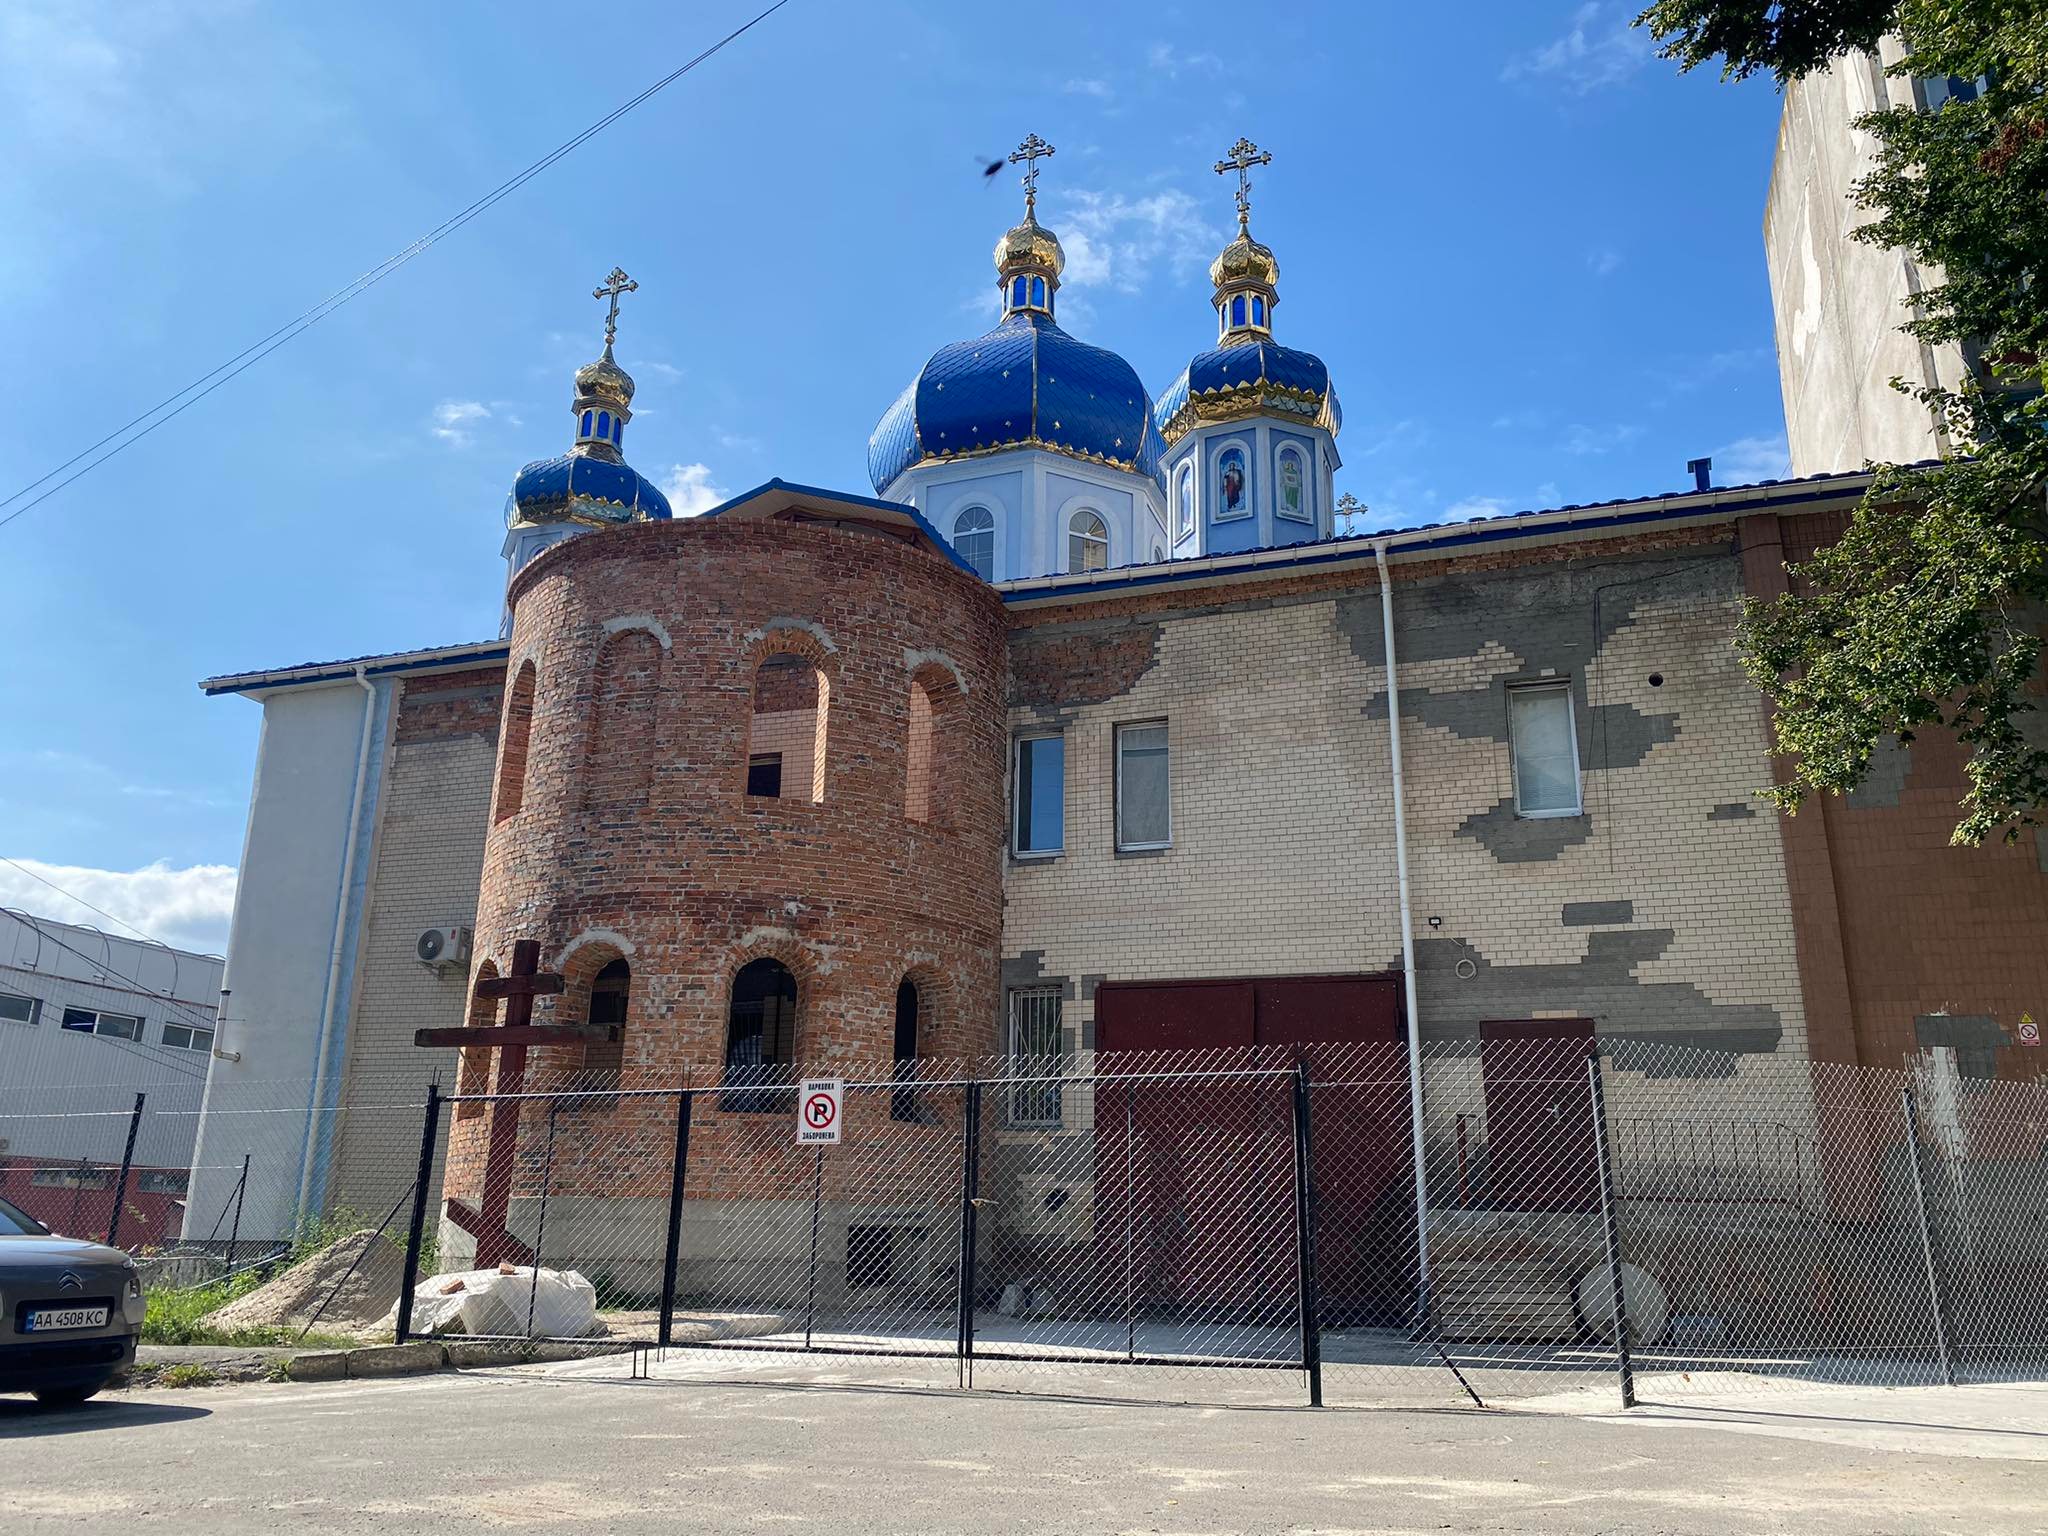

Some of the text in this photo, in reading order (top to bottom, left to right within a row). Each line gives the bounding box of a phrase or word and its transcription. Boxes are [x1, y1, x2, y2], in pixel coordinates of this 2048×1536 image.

[35, 1311, 103, 1327] AA 4508 KC
